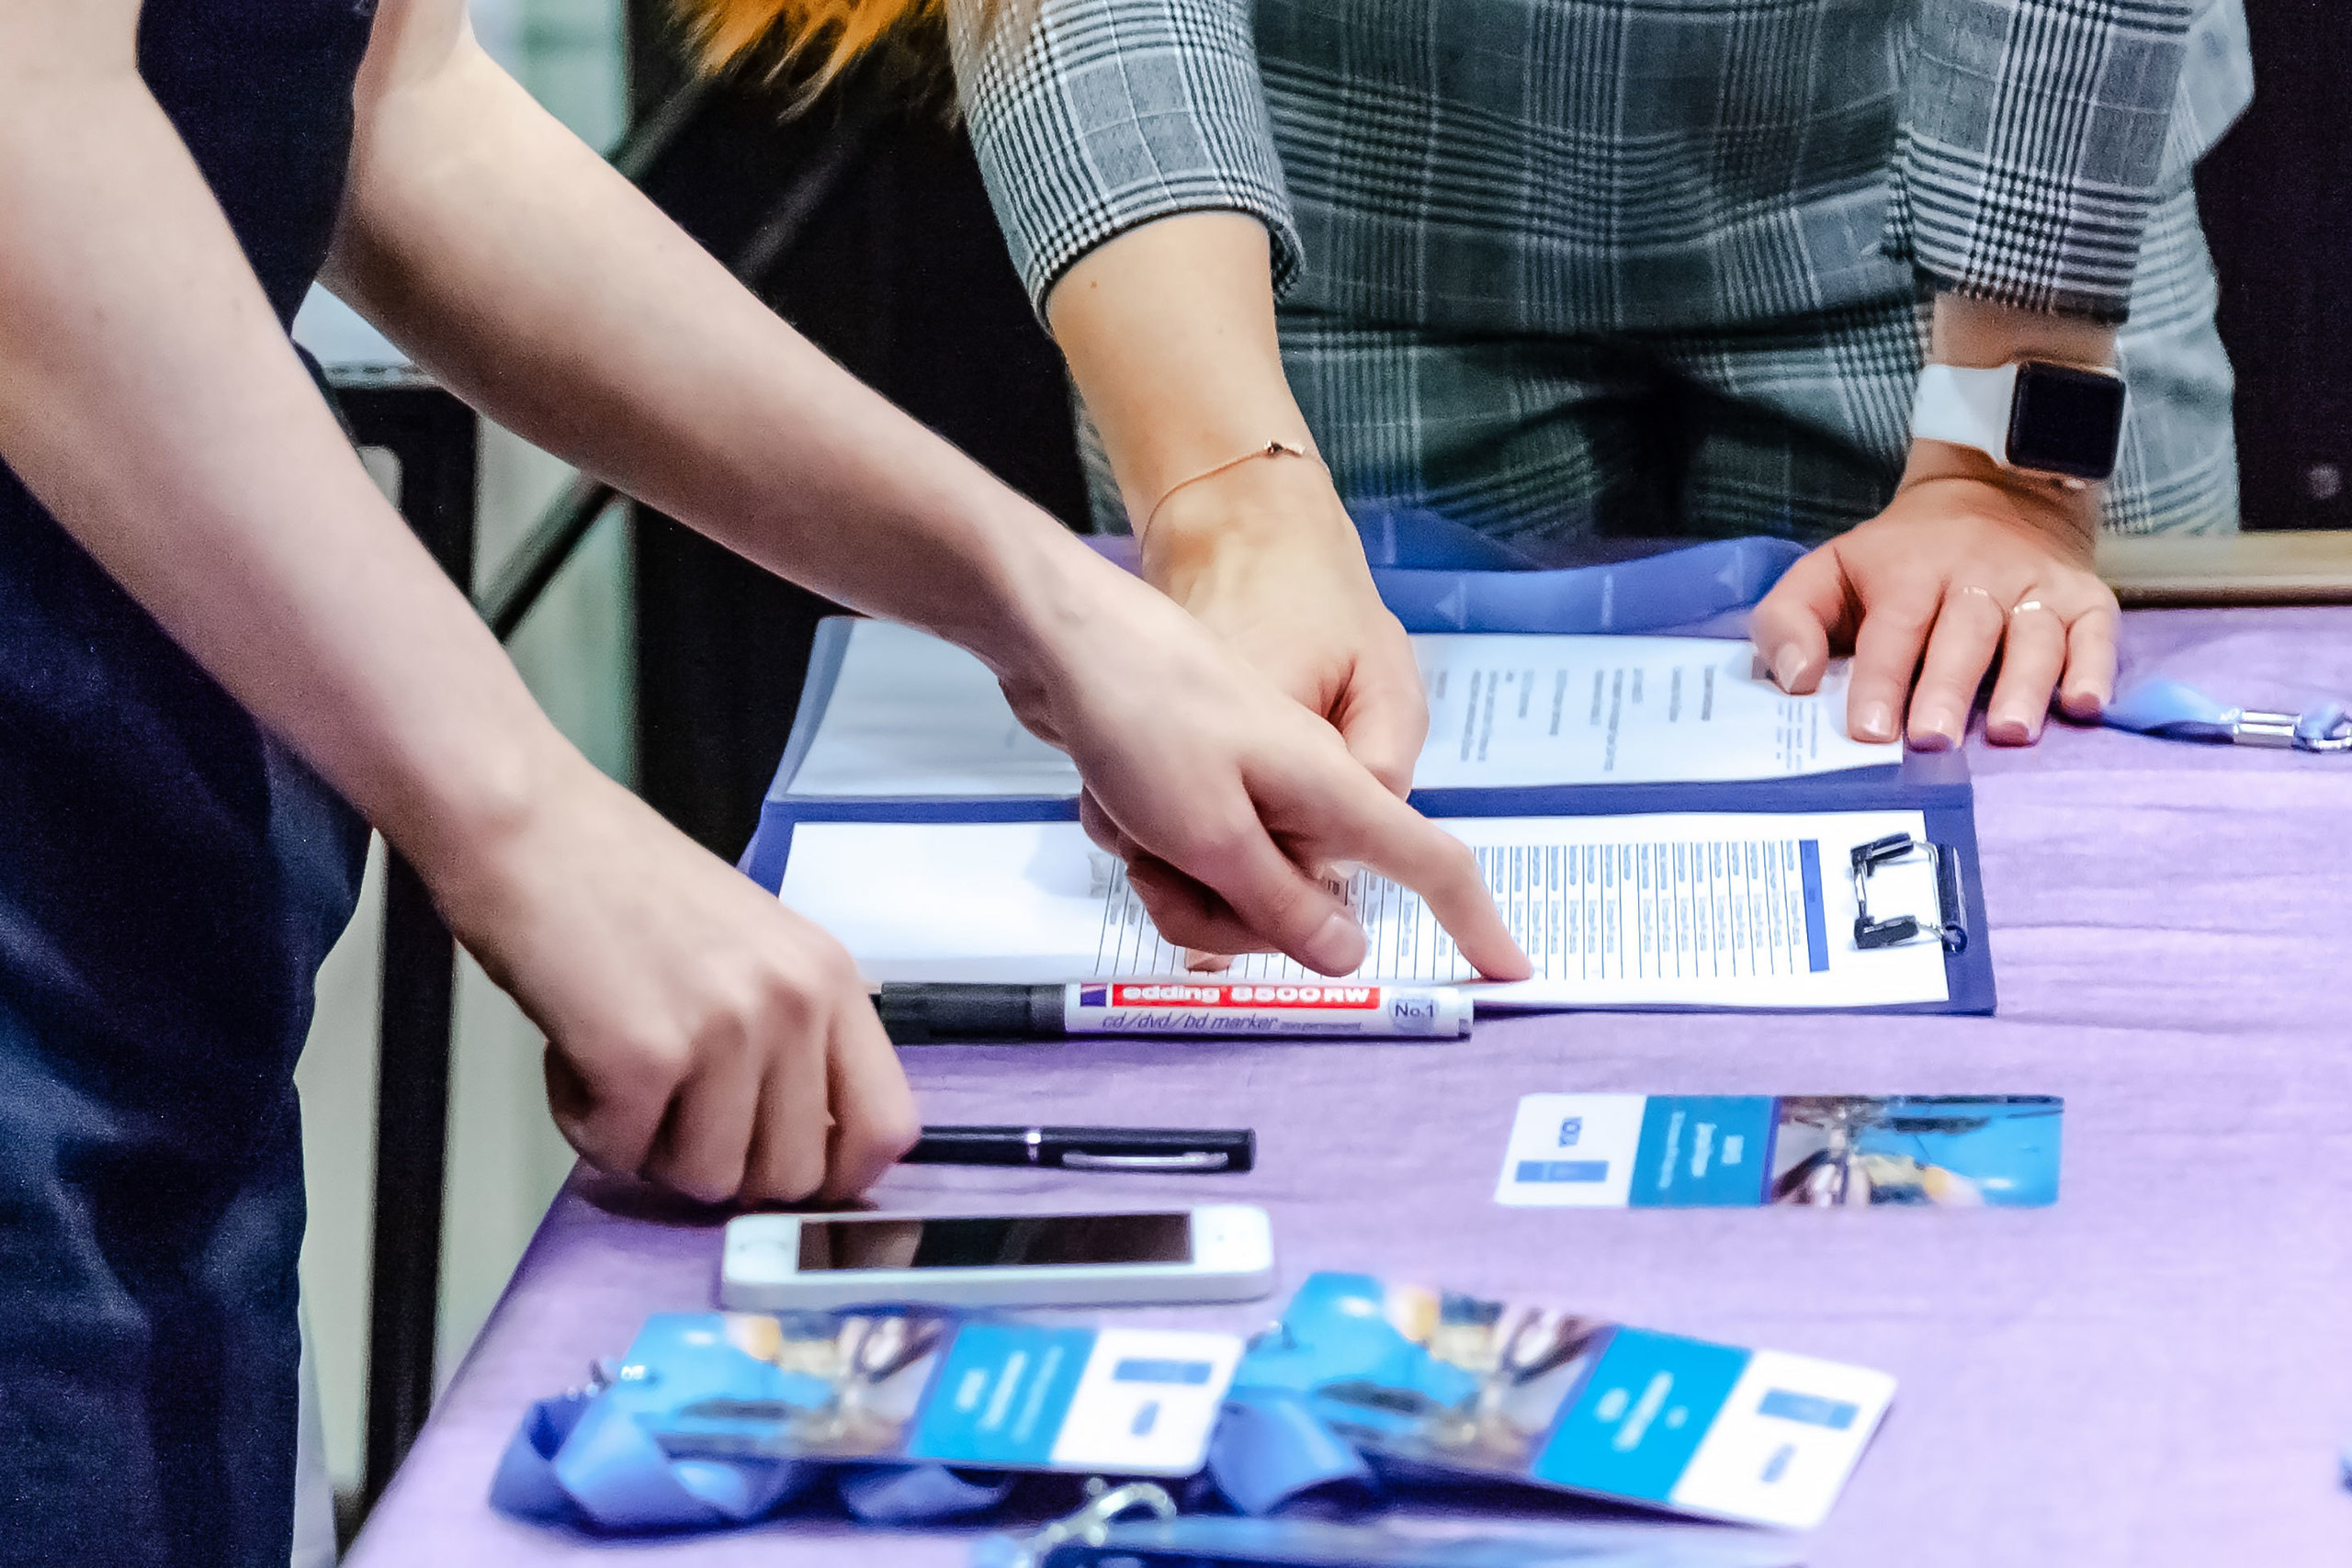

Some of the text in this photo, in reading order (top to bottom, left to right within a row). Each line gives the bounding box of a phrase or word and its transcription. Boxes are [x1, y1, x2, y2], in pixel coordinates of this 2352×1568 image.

[1123, 985, 1220, 1003] edding
[1102, 1010, 1210, 1030] cd/dvd/bd
[1211, 1012, 1279, 1030] marker
